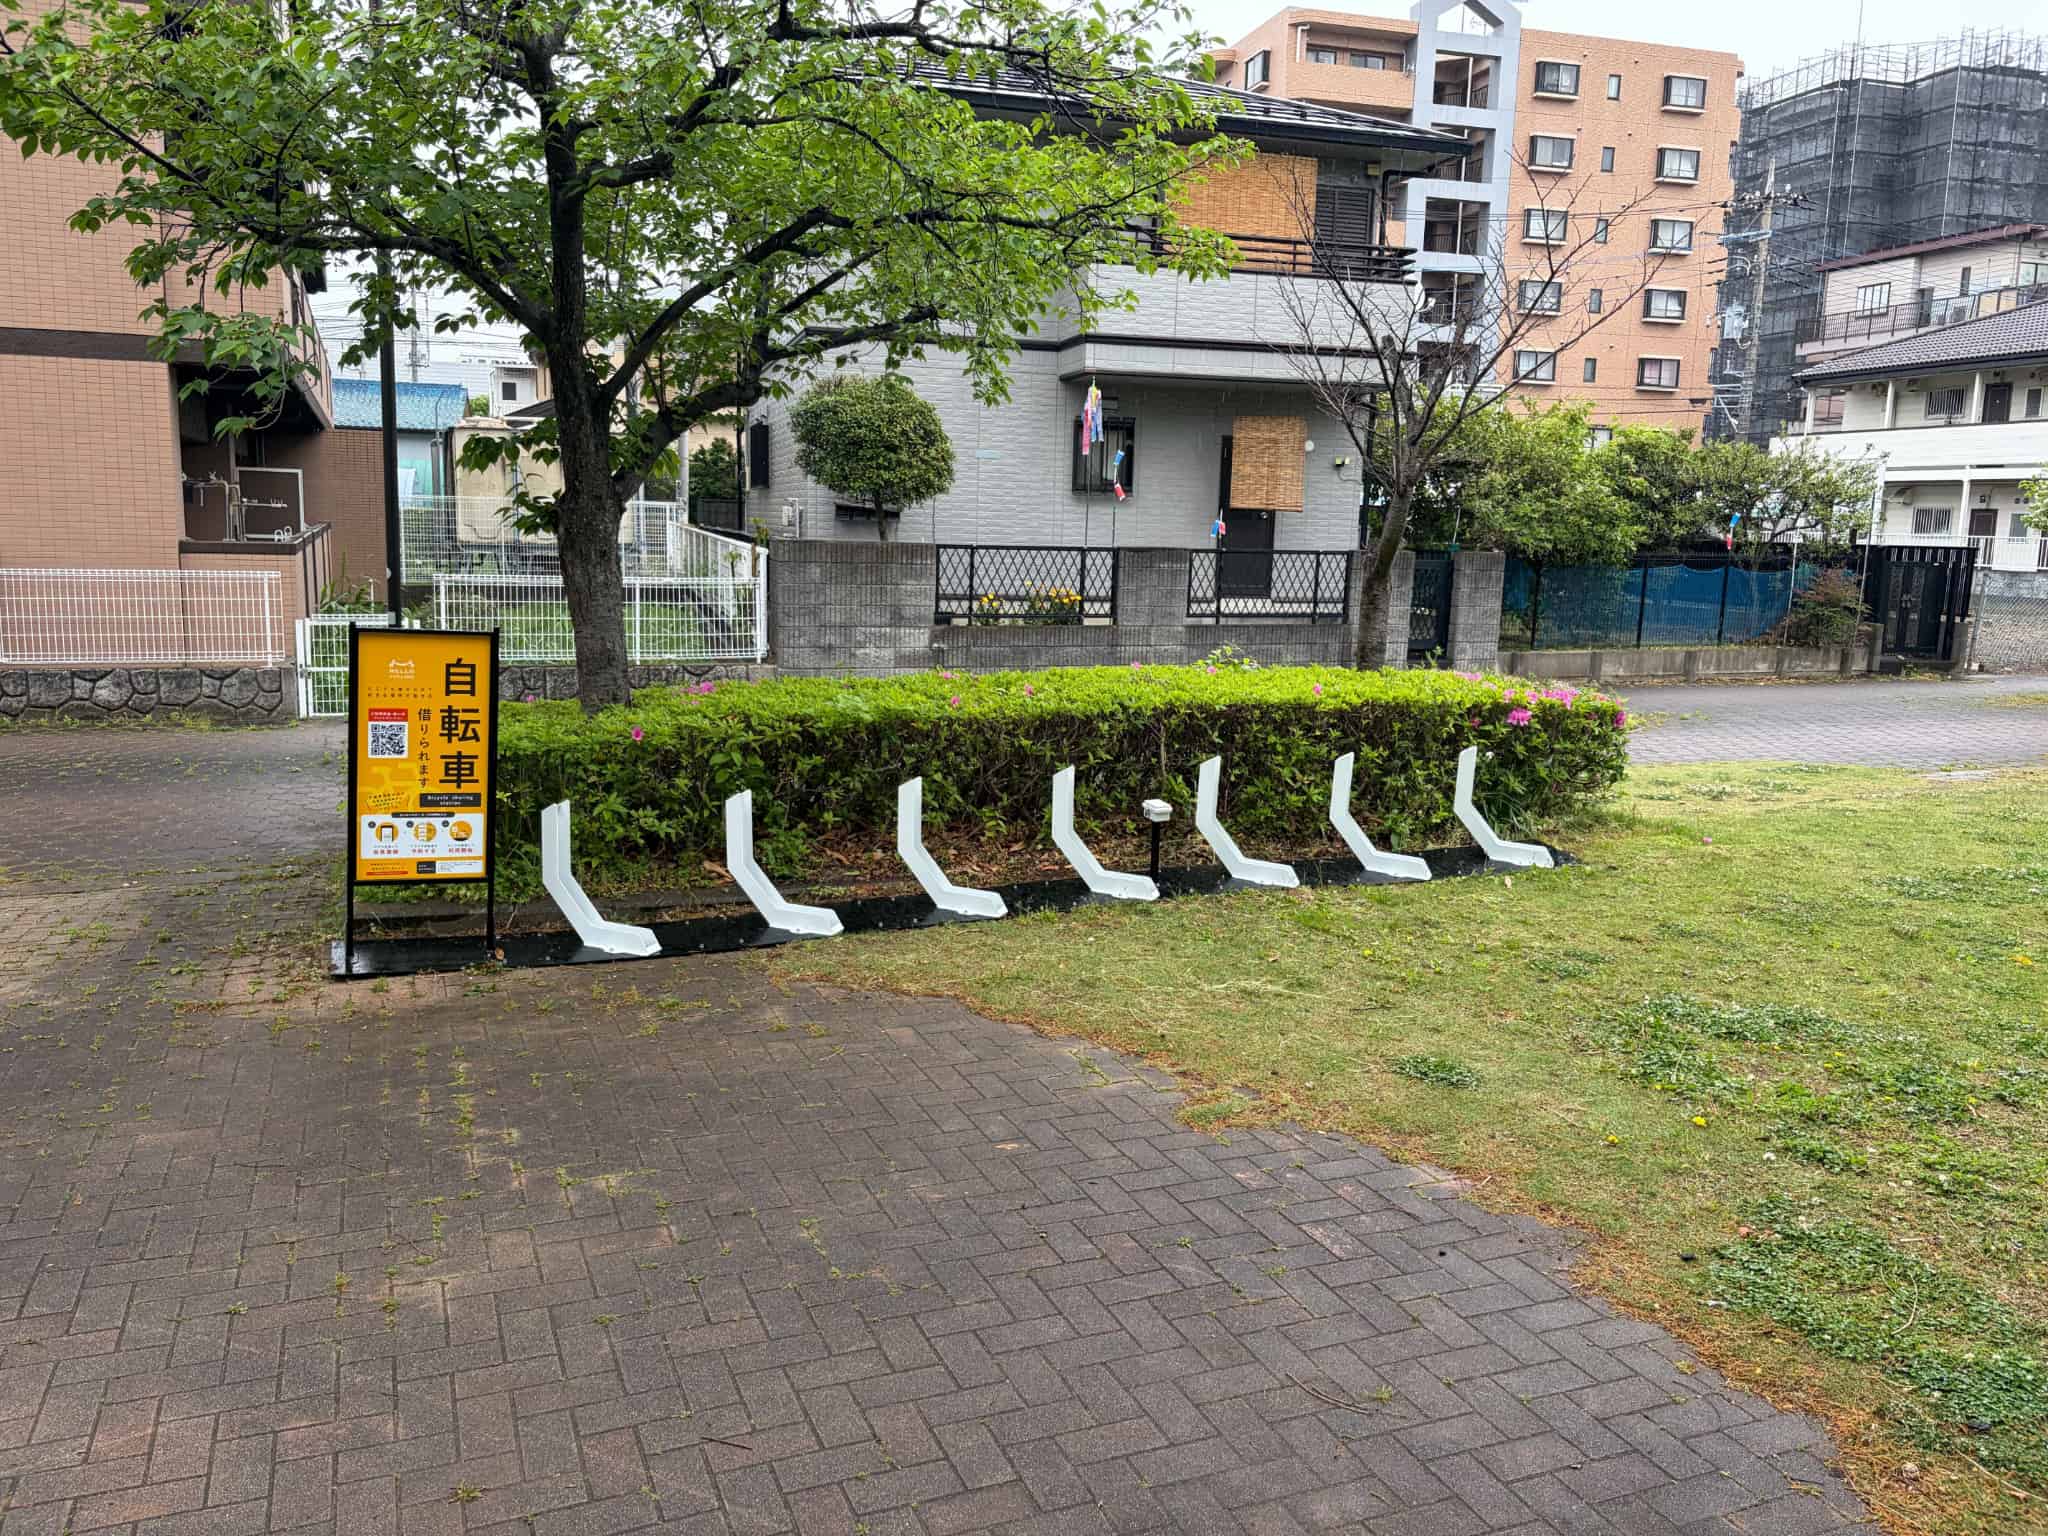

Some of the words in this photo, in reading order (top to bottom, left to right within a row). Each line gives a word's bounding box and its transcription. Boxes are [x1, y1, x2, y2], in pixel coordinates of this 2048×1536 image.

[418, 708, 432, 788] 借りられます
[439, 657, 480, 789] 自転車
